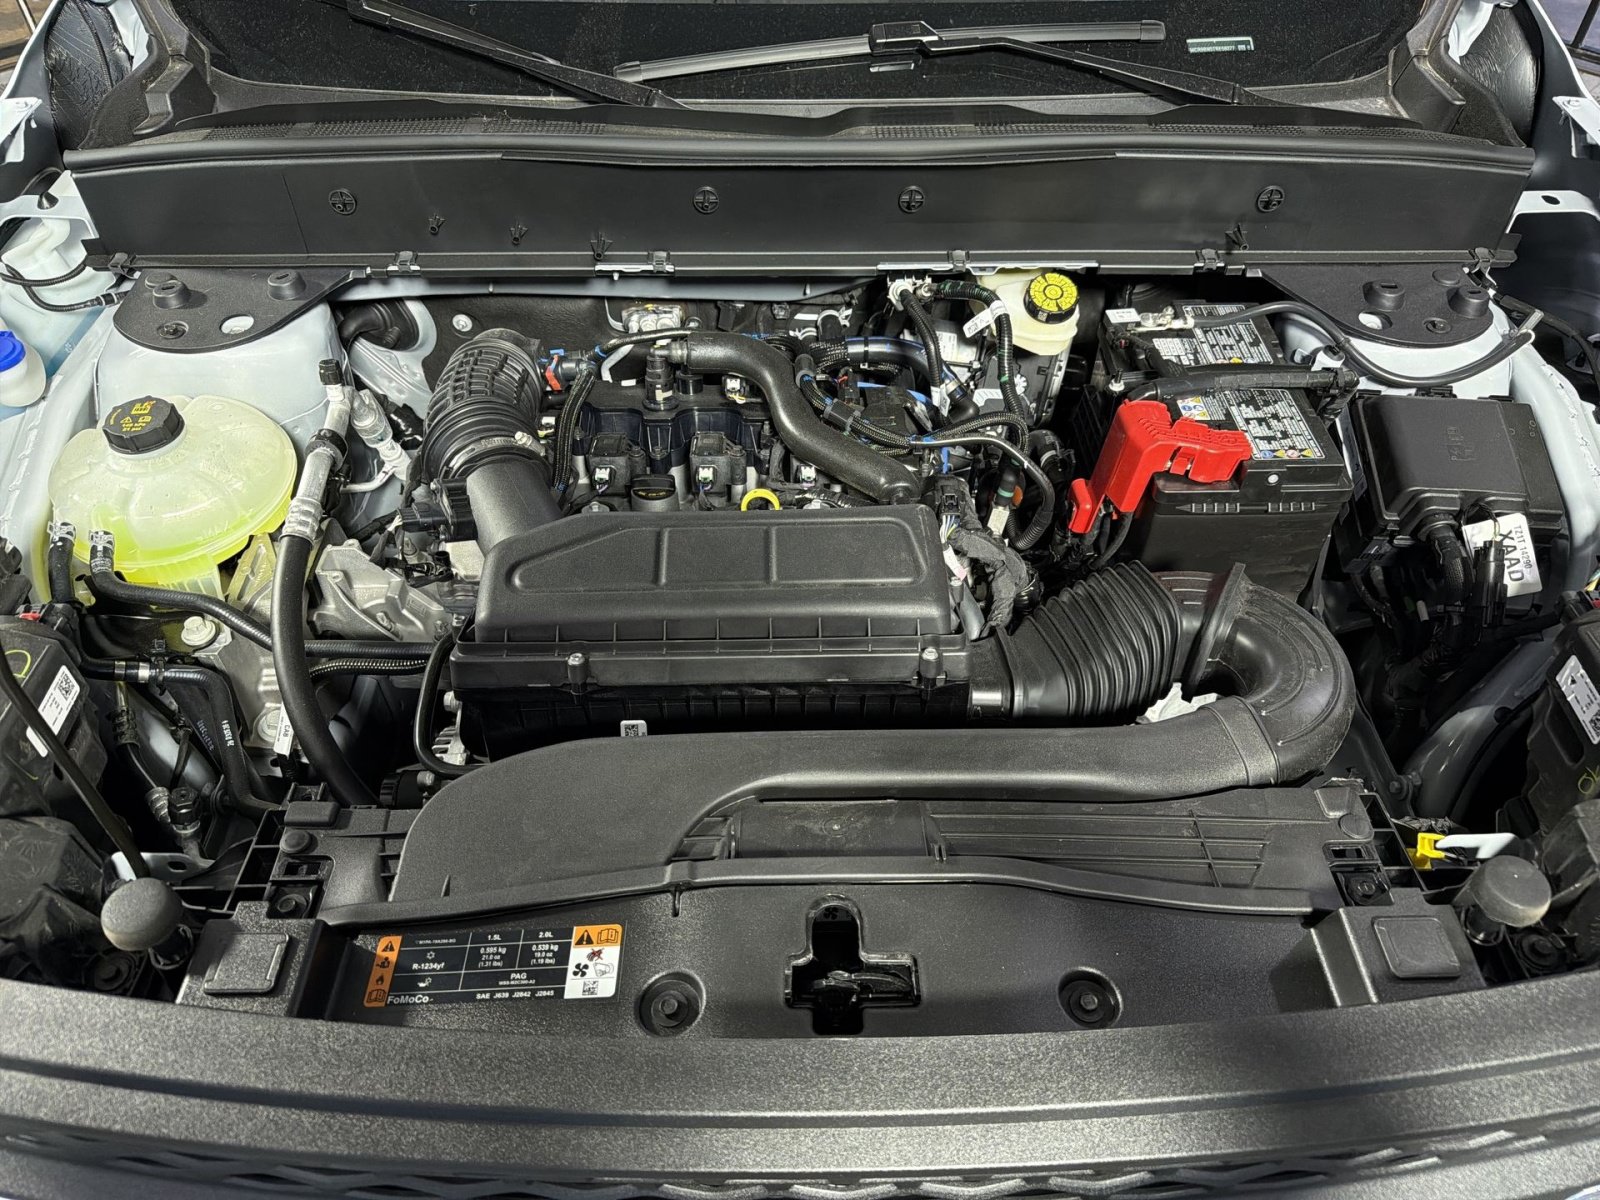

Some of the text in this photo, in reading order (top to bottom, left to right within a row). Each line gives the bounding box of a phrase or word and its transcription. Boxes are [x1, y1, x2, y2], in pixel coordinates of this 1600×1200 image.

[1500, 530, 1524, 582] XAAD
[1520, 546, 1532, 569] 14290
[498, 946, 507, 954] kg
[550, 944, 559, 952] kg
[412, 961, 445, 971] R-1234yf
[510, 972, 527, 980] PAG
[386, 994, 429, 1005] FoMoCo
[476, 992, 491, 1000] SAE
